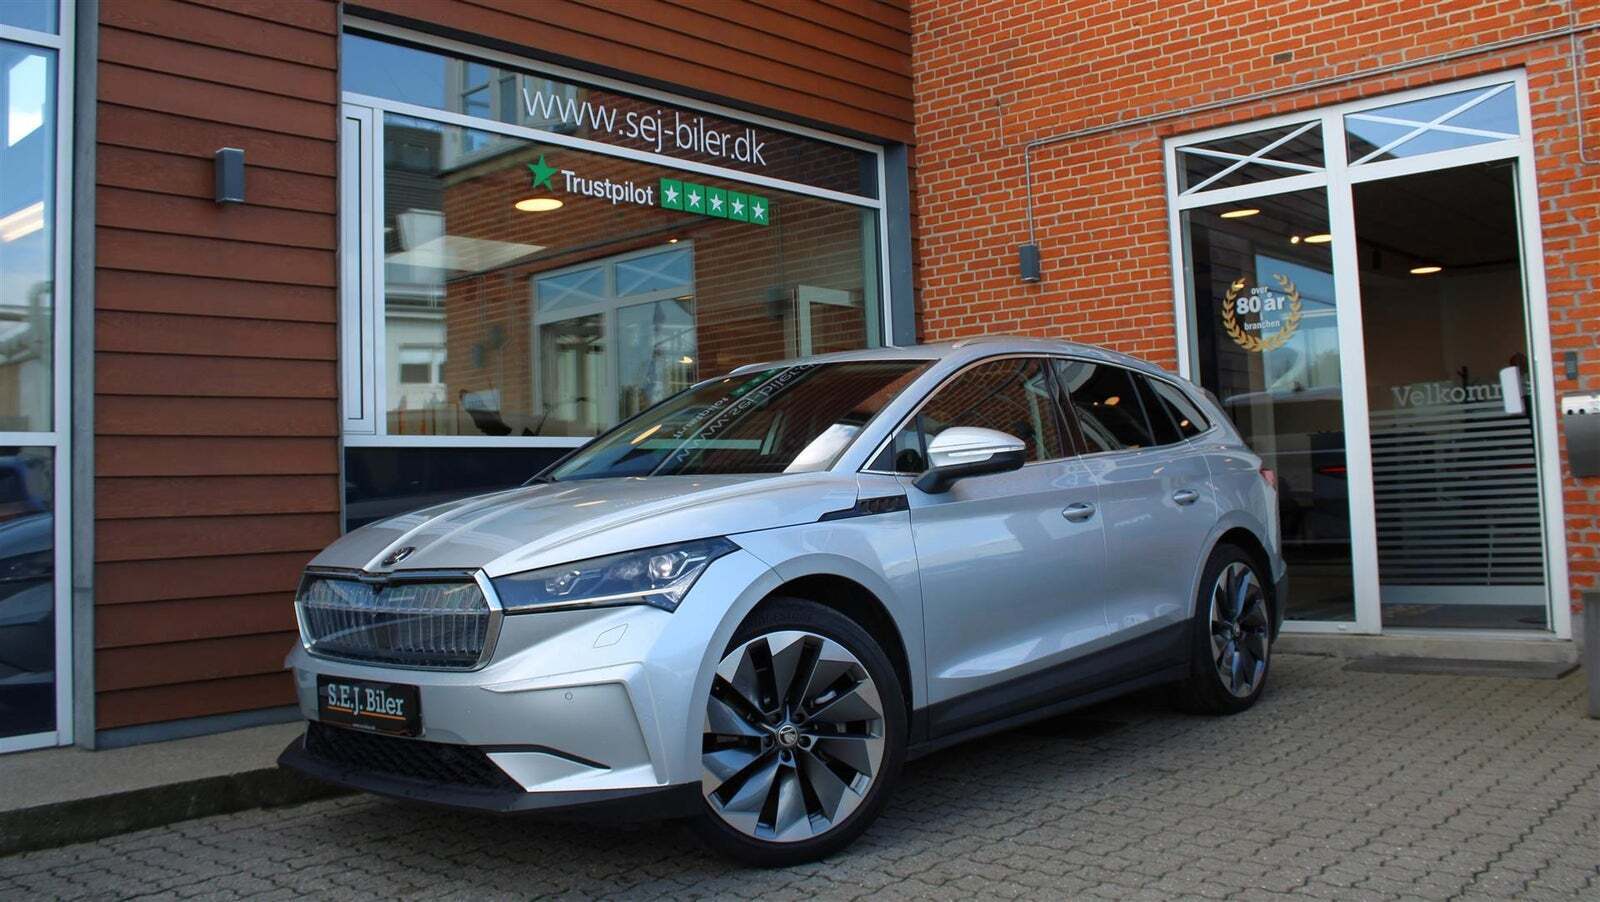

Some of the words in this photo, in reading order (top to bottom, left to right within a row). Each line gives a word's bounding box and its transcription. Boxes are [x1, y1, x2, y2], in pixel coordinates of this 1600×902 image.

[523, 87, 767, 166] www.sej-biler.dk
[561, 169, 654, 206] Trustpilot
[1236, 296, 1261, 315] 80
[1264, 292, 1285, 311] år
[1251, 286, 1269, 295] over
[1244, 319, 1280, 331] branchen
[1391, 379, 1532, 407] Velkom
[327, 683, 363, 716] S.E.J.
[365, 688, 404, 715] Biler
